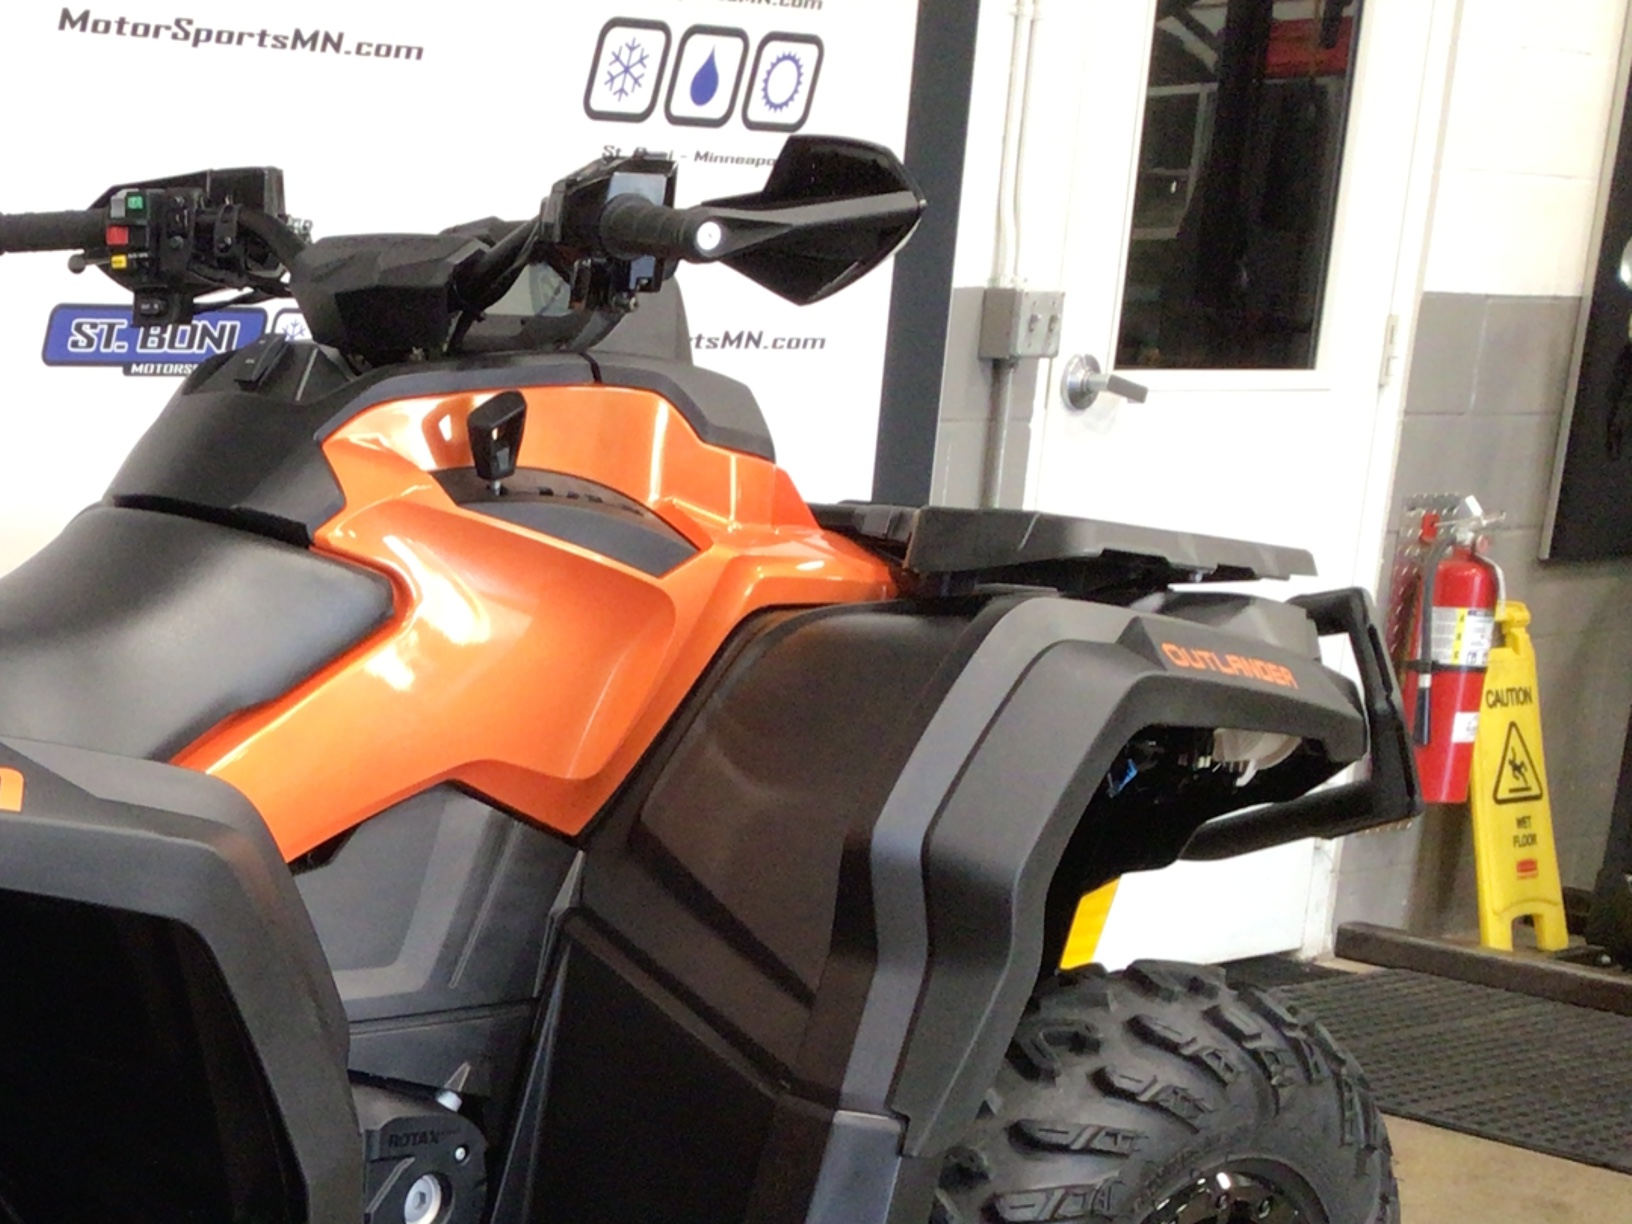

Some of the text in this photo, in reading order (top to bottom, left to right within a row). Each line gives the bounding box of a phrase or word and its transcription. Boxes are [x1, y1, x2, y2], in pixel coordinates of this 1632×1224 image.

[58, 7, 424, 61] MotorSportsMN.com
[694, 150, 777, 167] Minneapo
[69, 319, 241, 353] ST. BONI
[130, 362, 198, 375] MOTORS
[1160, 641, 1300, 690] OUTLANDER
[1485, 686, 1533, 709] CAUTION
[1515, 815, 1532, 830] WET
[1513, 833, 1538, 849] FLOOR
[388, 1129, 439, 1148] ROTAX
